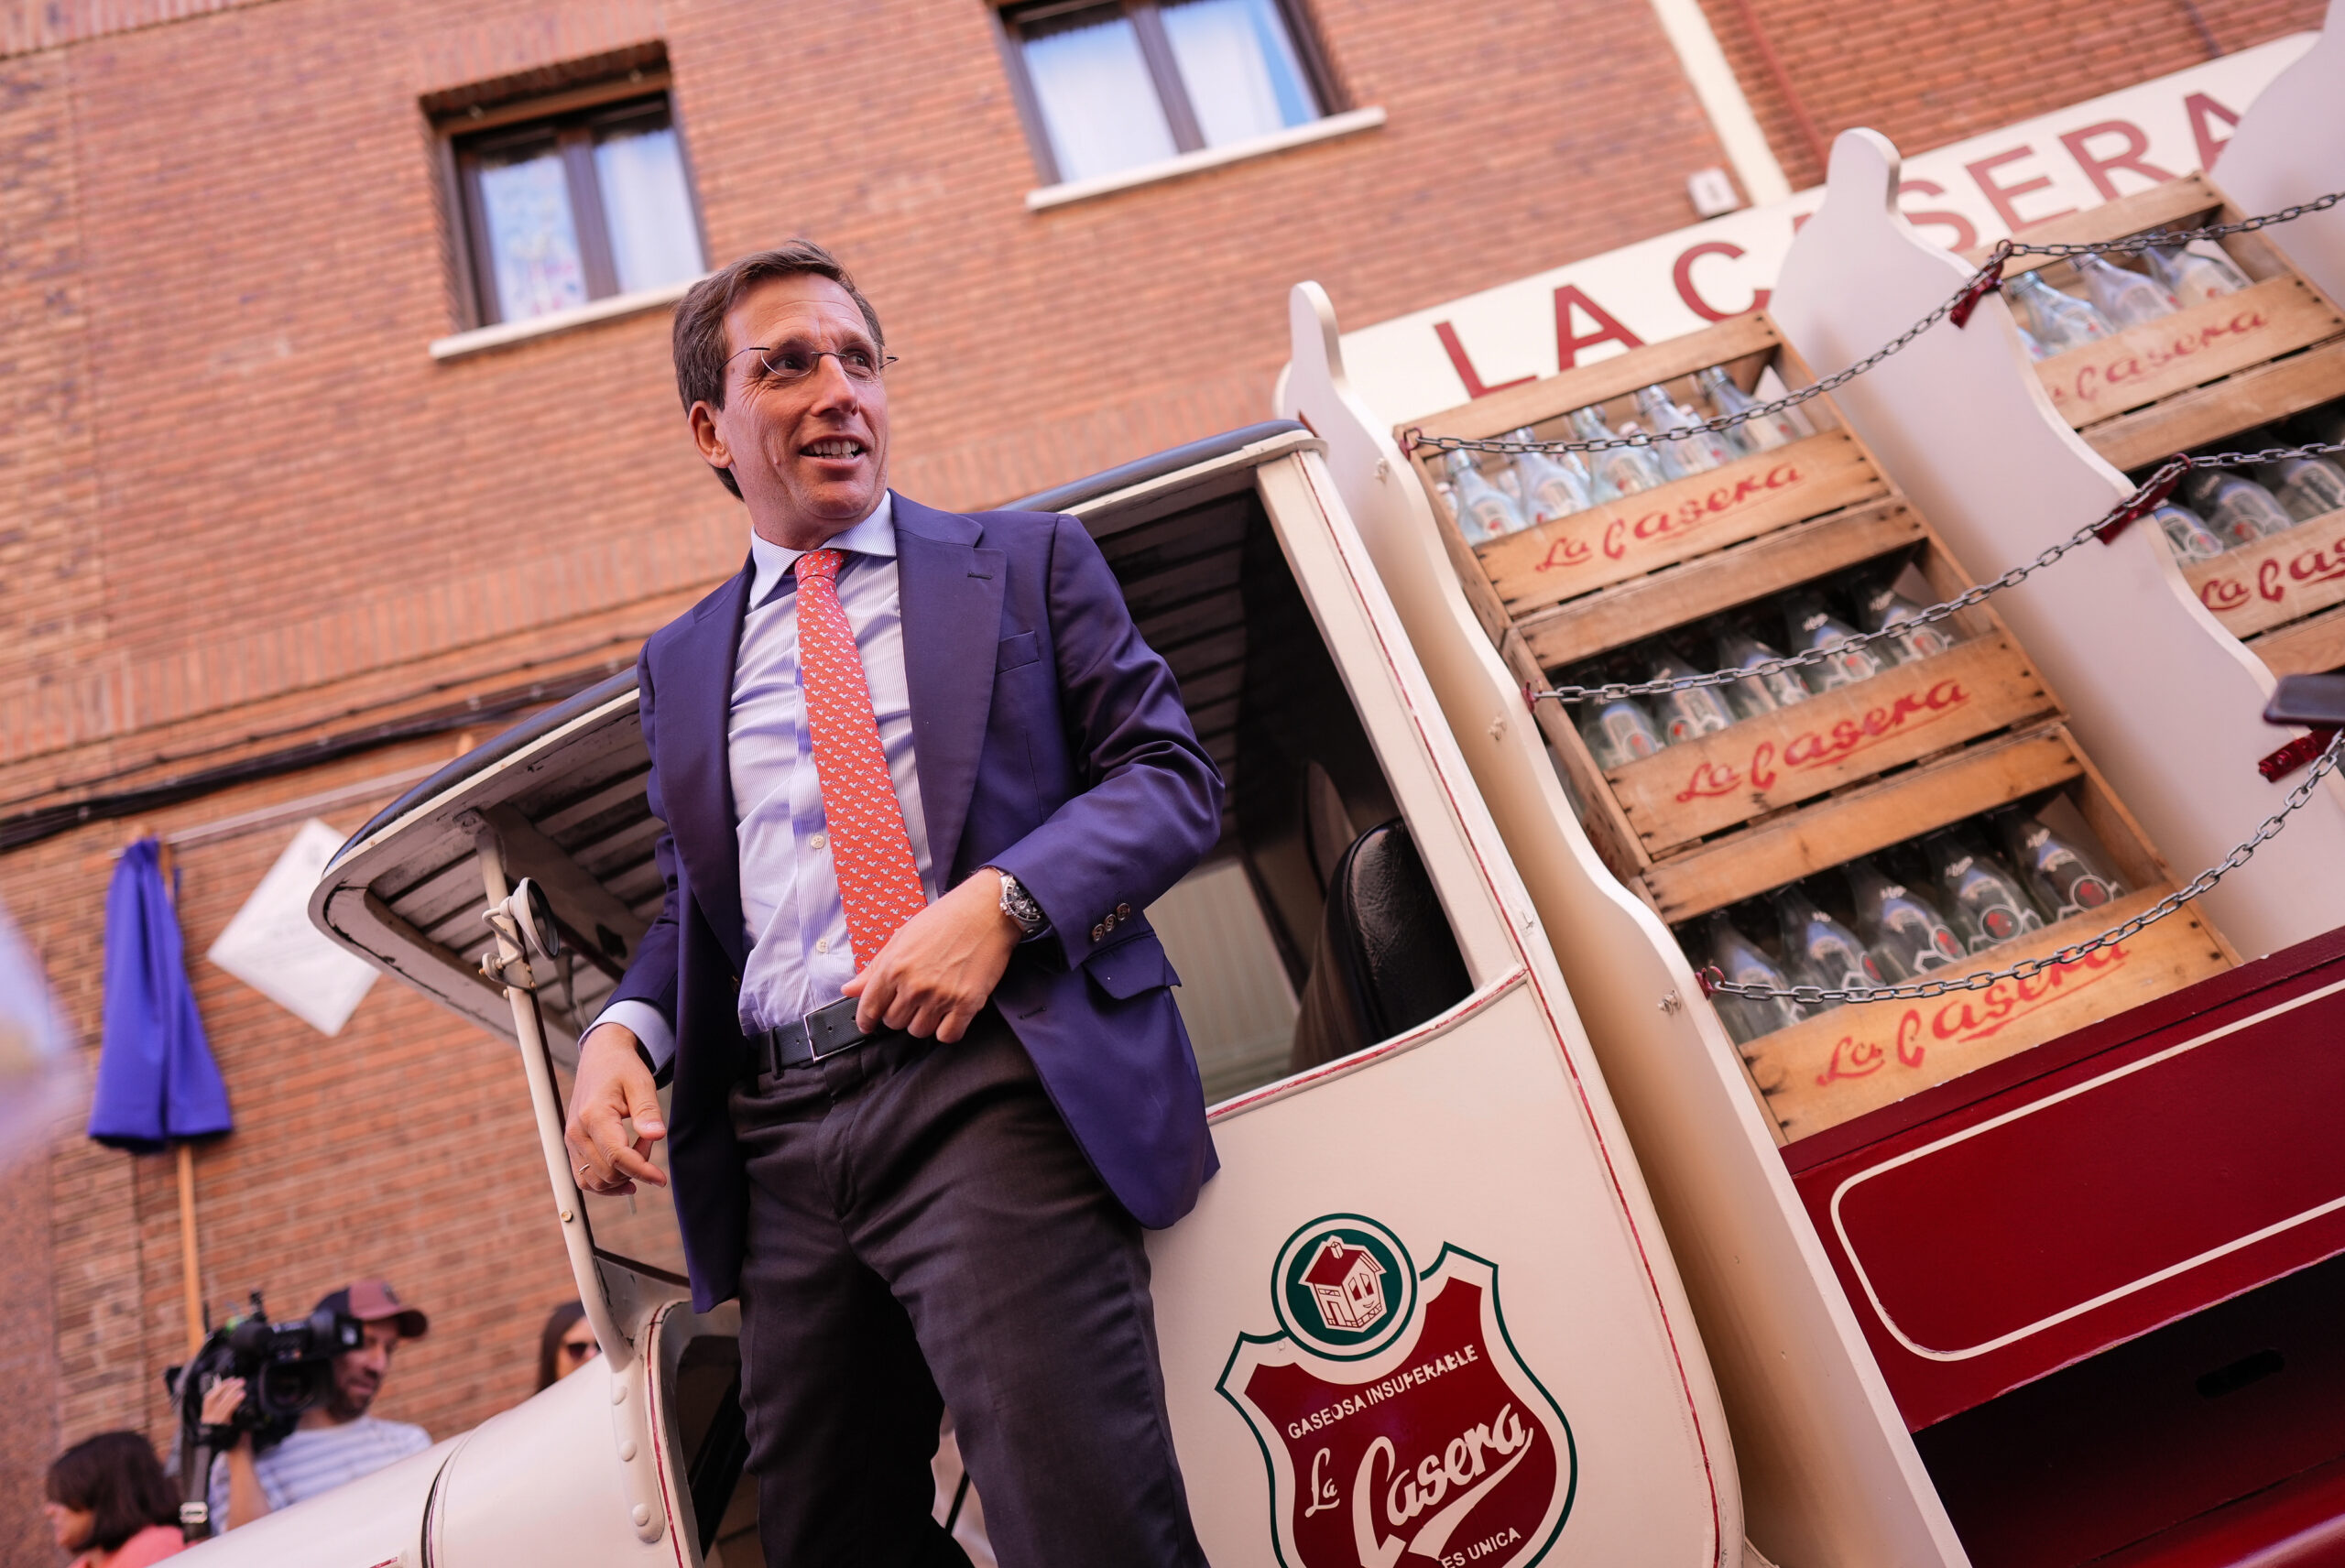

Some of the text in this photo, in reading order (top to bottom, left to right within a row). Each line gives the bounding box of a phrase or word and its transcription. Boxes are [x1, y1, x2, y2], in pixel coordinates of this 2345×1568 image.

[1434, 92, 2242, 399] LA CSERA
[2076, 310, 2269, 401] Casera
[1534, 462, 1806, 573] La Casera
[1676, 679, 1970, 802] La Casera
[1816, 1036, 1885, 1086] La
[1288, 1345, 1478, 1439] GASEOSA INSUPERABLE
[1305, 1402, 1534, 1568] La Casera
[1467, 1527, 1522, 1560] UNICA
